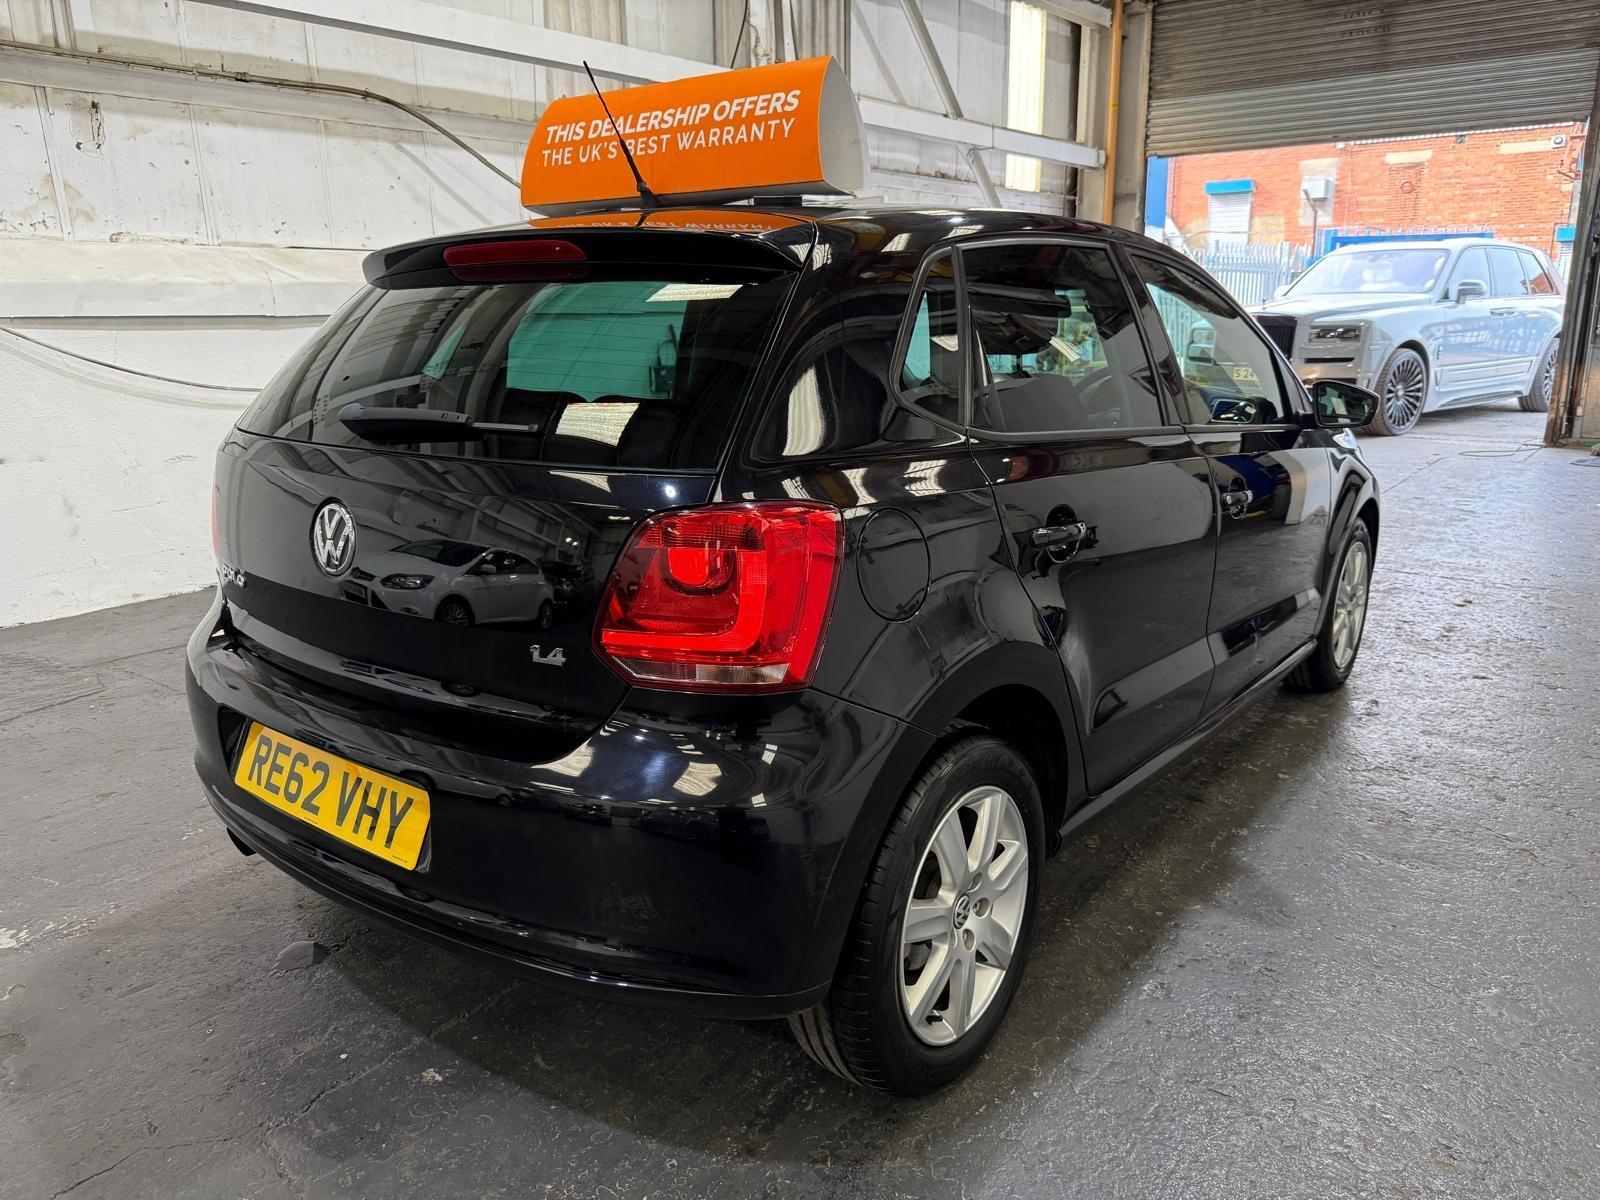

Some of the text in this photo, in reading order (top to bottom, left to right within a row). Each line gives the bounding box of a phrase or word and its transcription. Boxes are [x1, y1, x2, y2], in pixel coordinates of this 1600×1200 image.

[542, 117, 795, 168] THE UK'S BEST WARRANTY
[546, 89, 801, 145] THIS DEALERSHIP OFFERS
[247, 733, 414, 850] RE62 VHY
